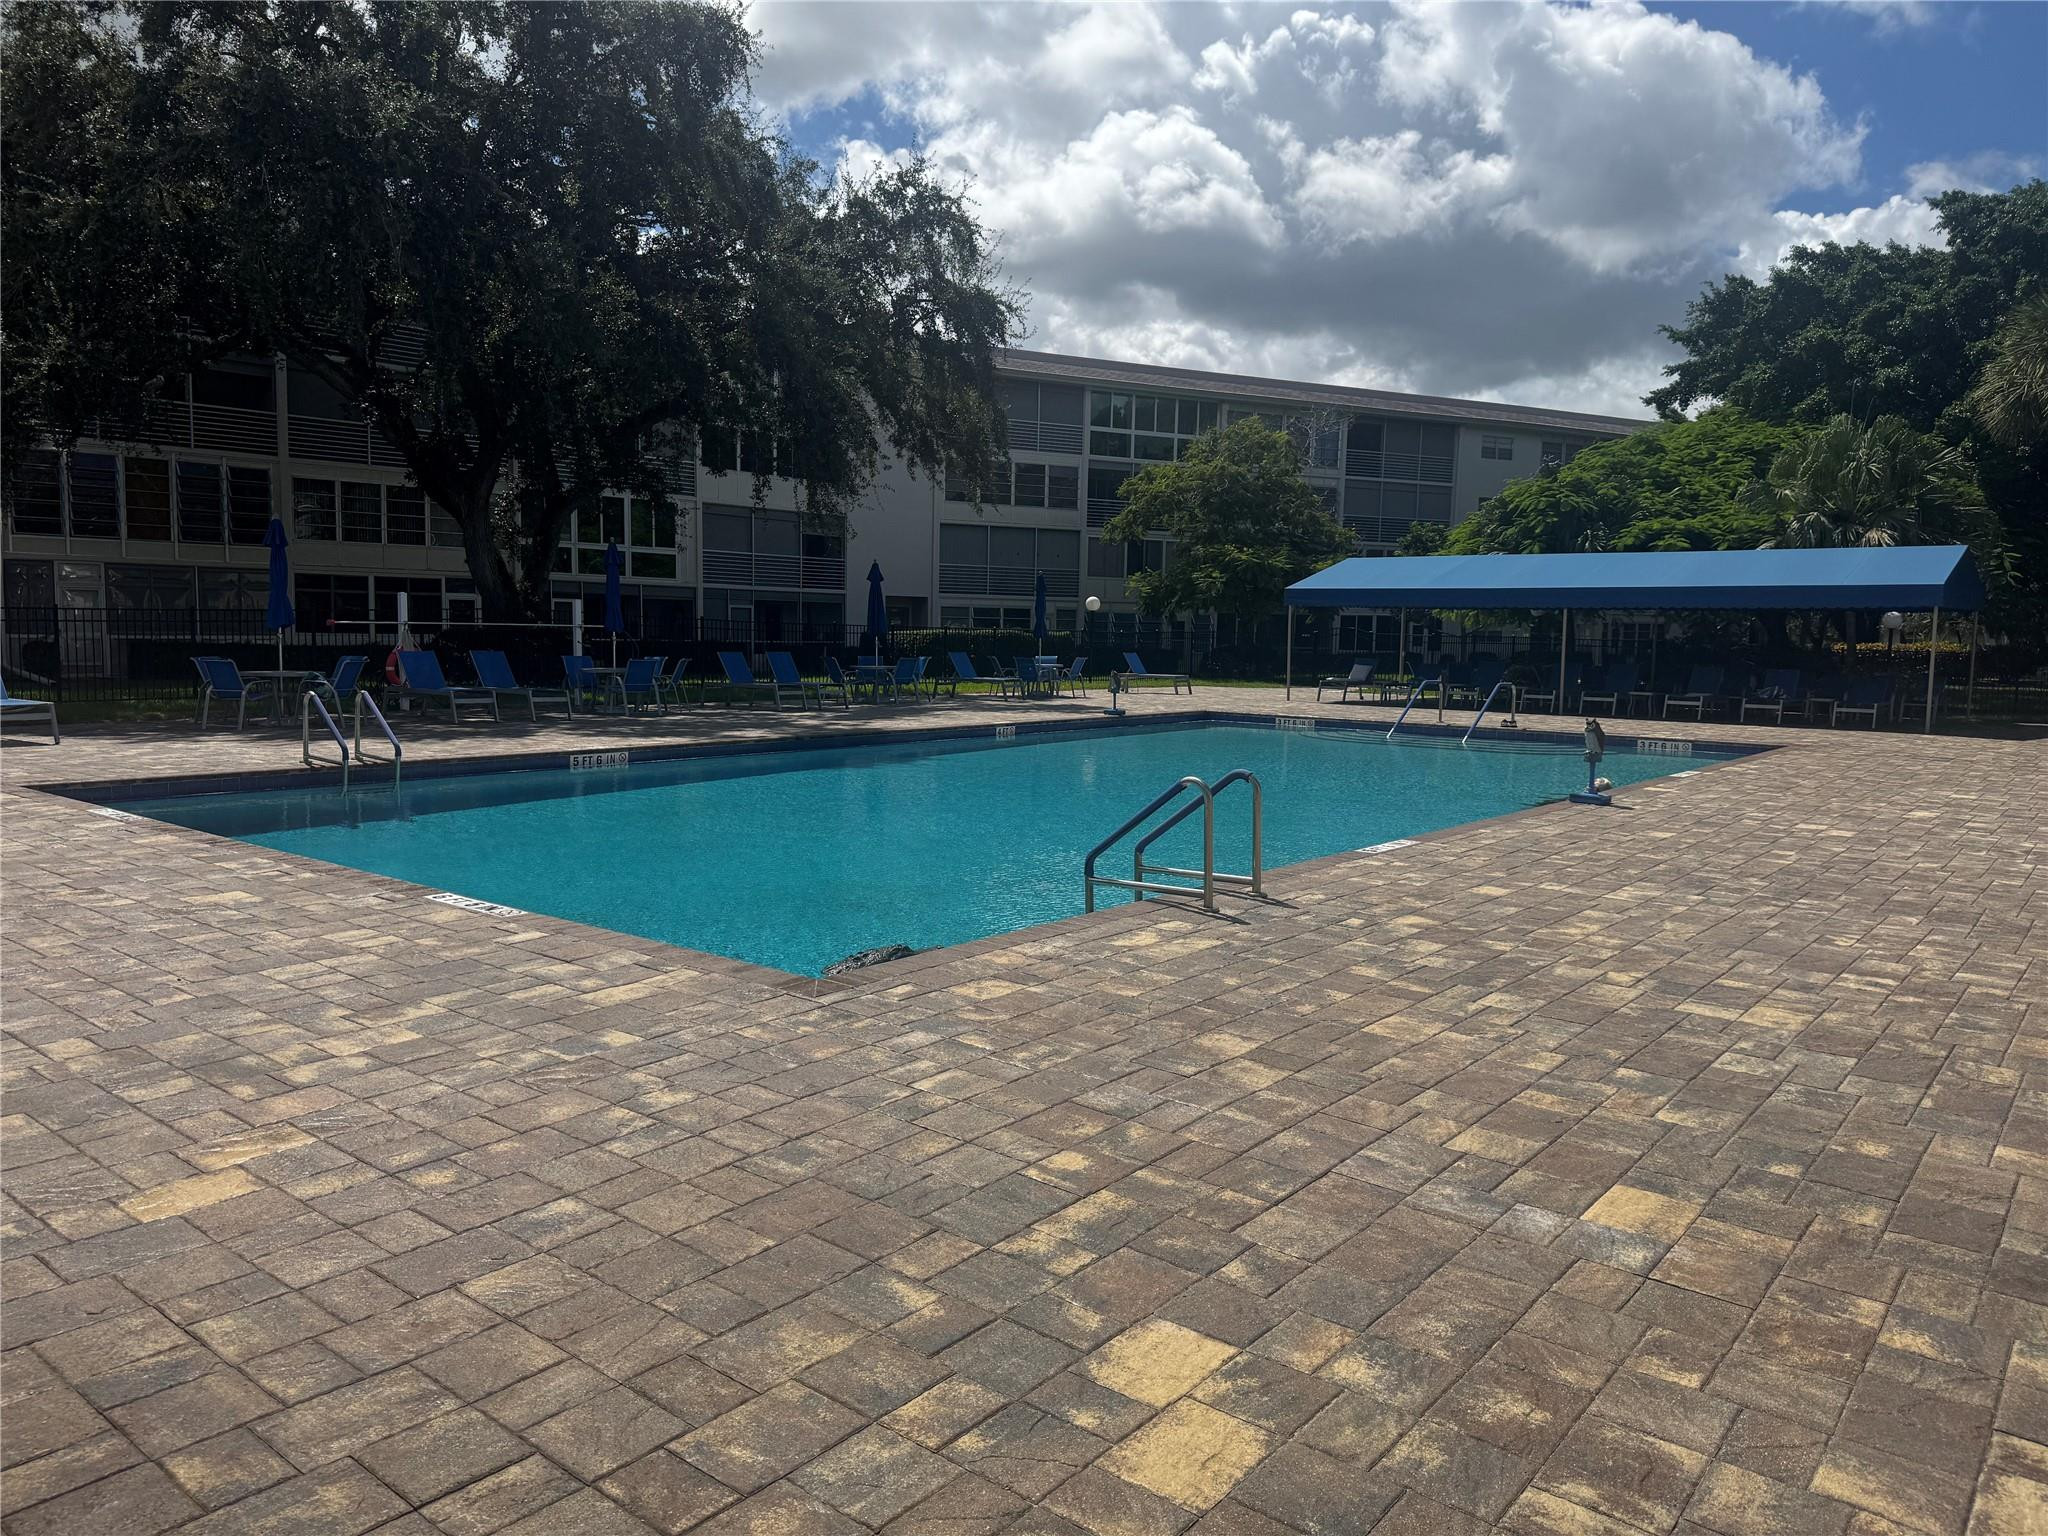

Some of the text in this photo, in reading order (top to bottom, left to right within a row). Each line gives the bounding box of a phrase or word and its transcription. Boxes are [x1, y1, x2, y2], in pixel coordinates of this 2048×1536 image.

[1648, 741, 1658, 750] FT
[1670, 742, 1679, 750] IN
[573, 753, 616, 766] 5 FT 6 IN
